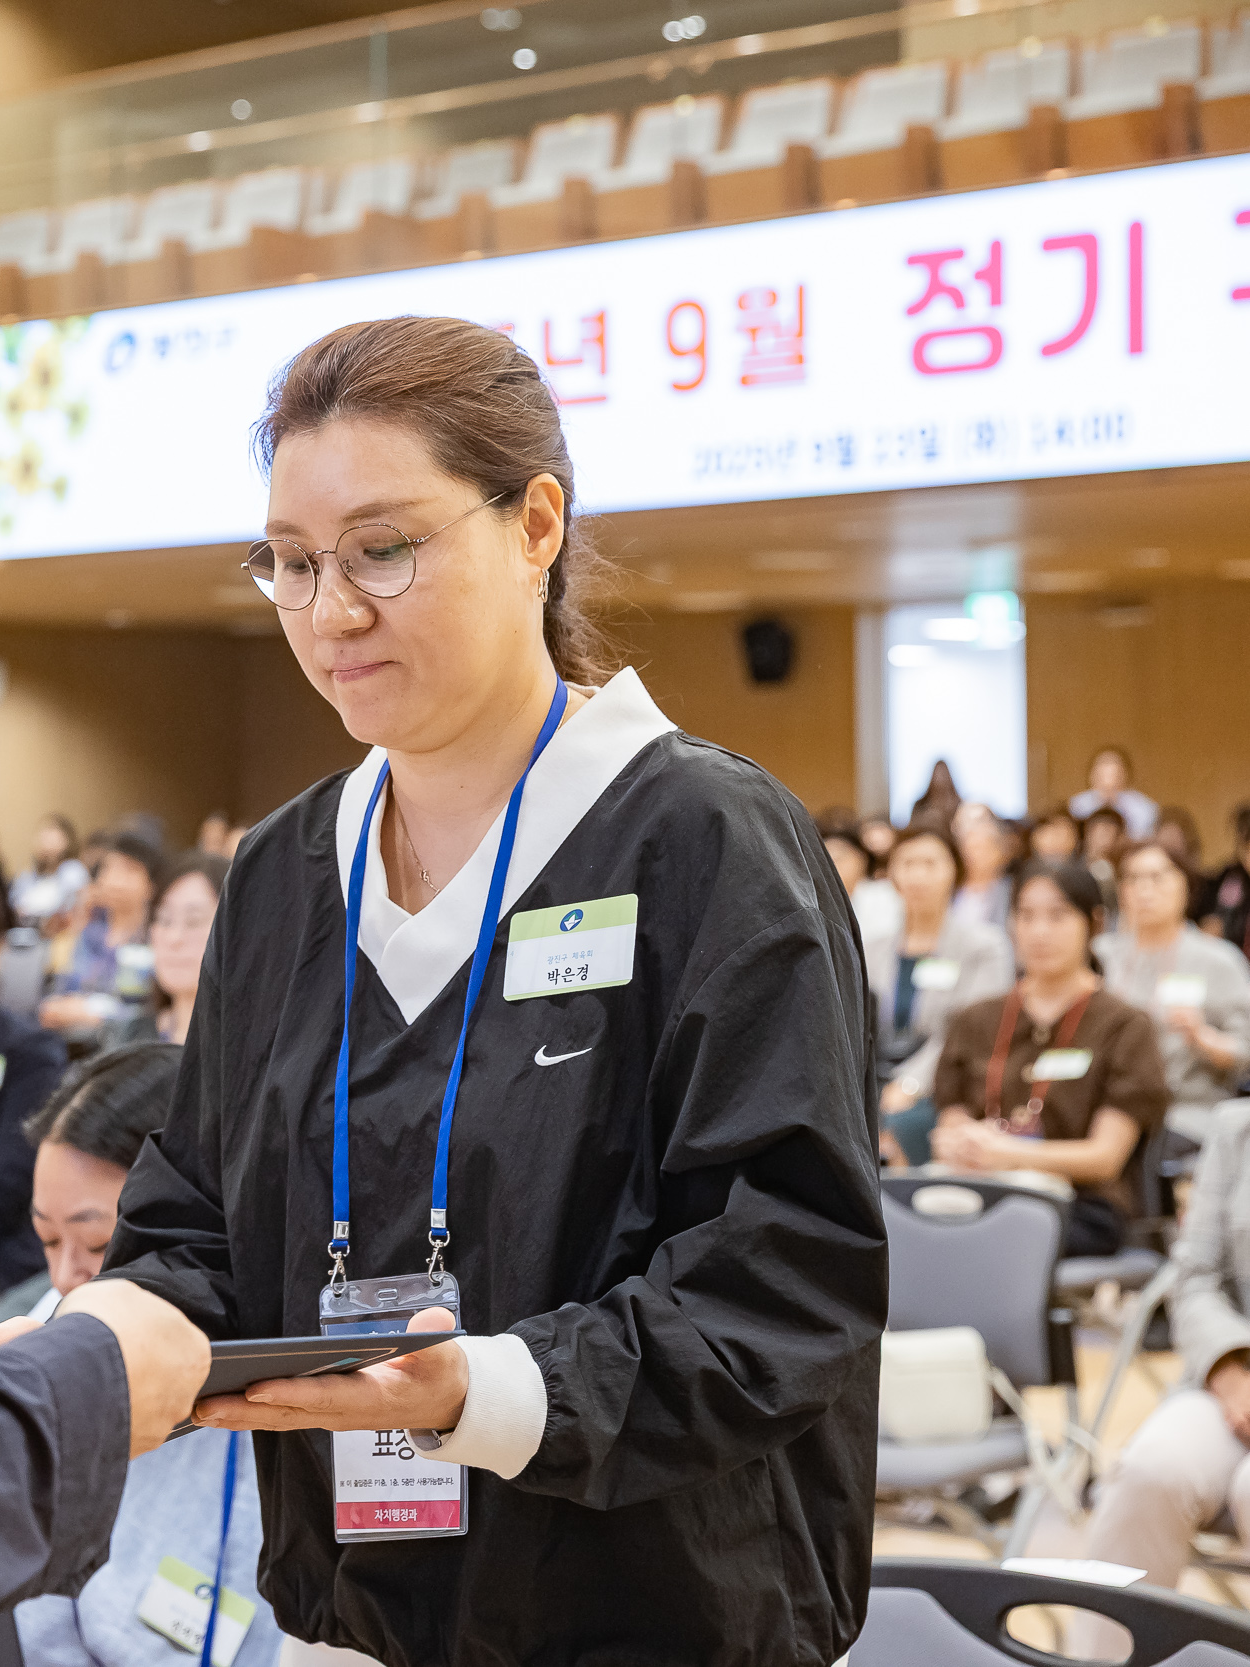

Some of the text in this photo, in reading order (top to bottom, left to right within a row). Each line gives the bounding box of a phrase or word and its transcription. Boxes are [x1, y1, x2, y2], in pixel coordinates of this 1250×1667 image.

[664, 284, 806, 391] 9월
[906, 221, 1143, 375] 정기
[547, 963, 589, 986] 박은경
[374, 1508, 418, 1522] 자치행정과
